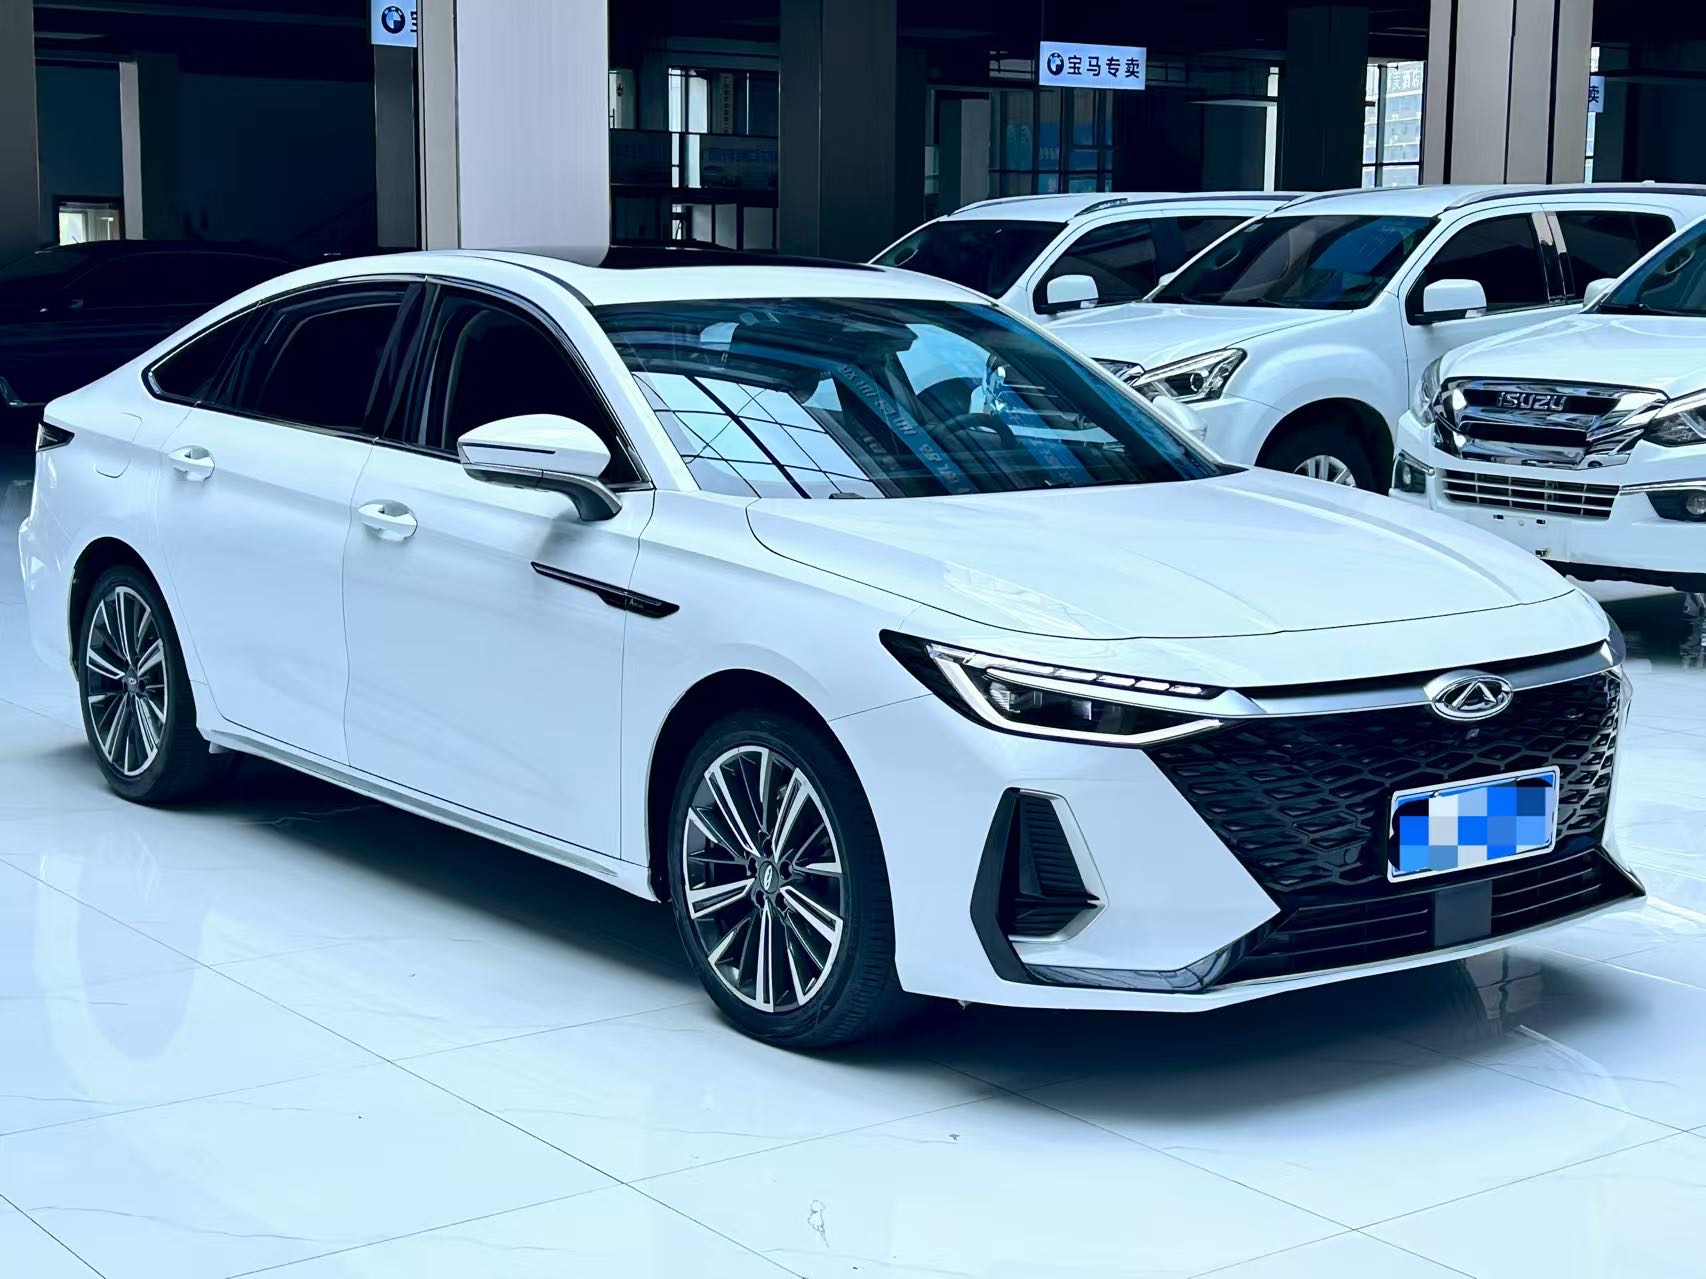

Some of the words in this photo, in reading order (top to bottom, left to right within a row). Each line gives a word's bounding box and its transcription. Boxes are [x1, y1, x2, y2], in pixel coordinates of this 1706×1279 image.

[1067, 55, 1140, 79] 宝马专卖
[1497, 391, 1567, 412] ISUZU
